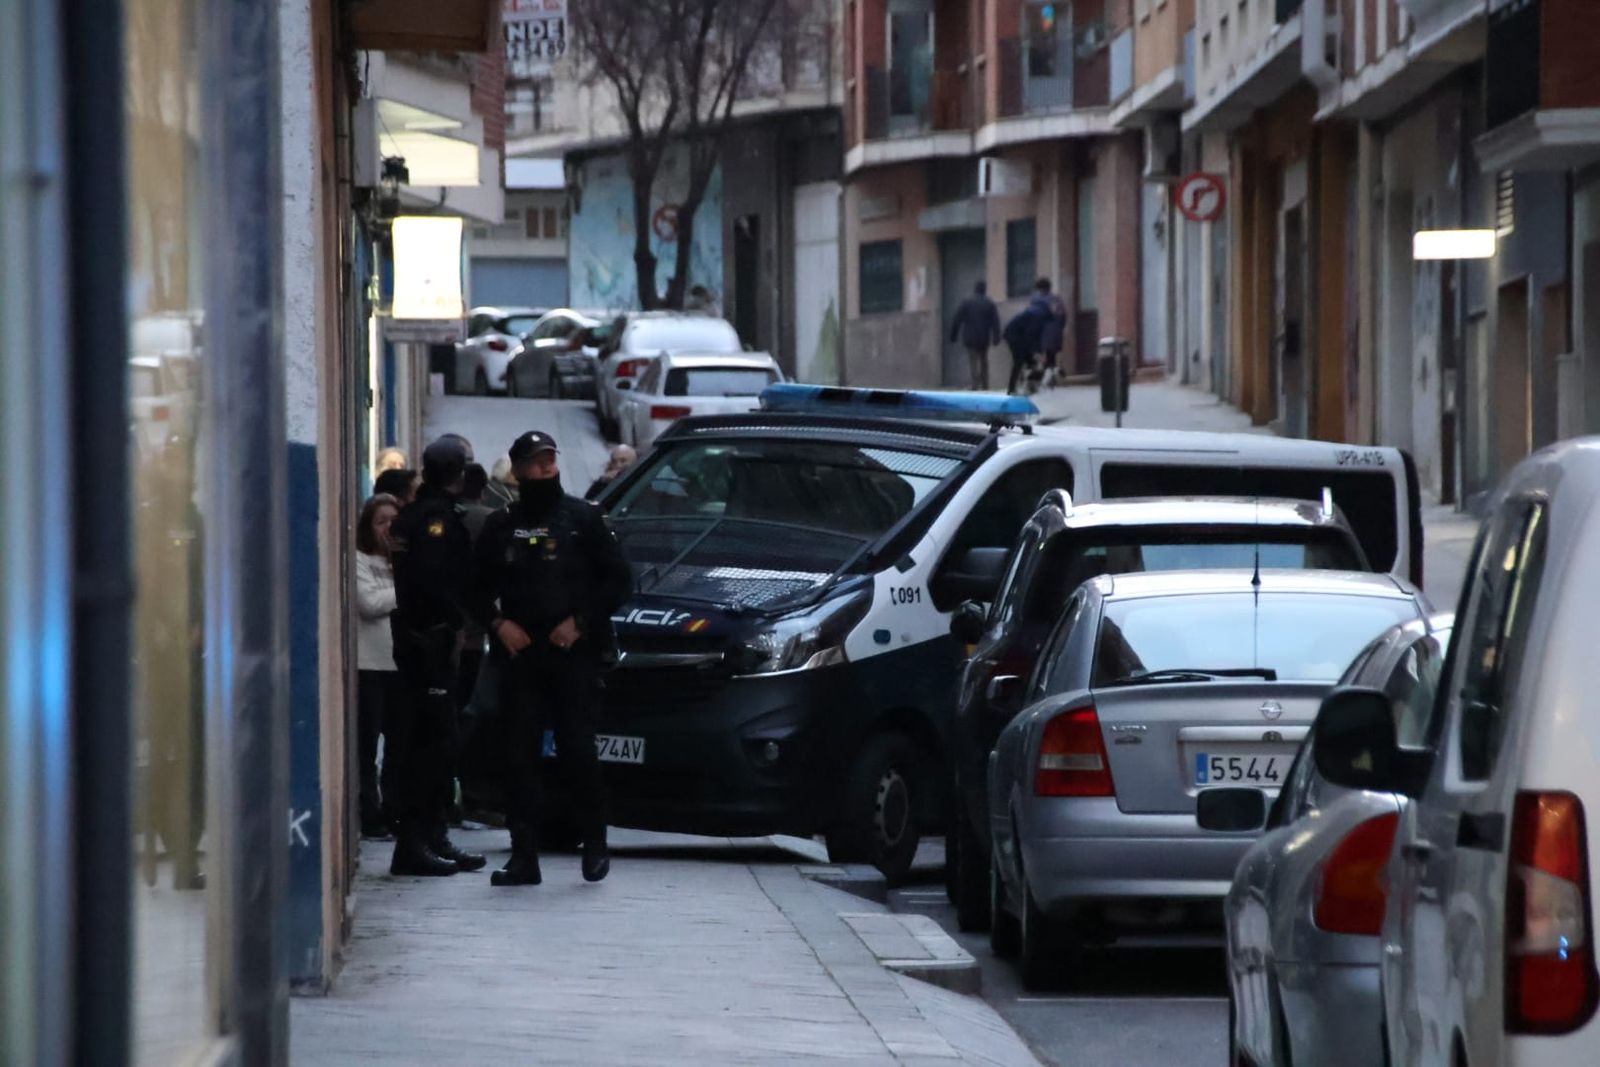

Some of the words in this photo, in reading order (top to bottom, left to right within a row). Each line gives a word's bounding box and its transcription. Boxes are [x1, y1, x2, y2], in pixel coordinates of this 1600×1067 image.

[898, 586, 921, 604] 091
[595, 737, 642, 761] 74AV
[1210, 756, 1279, 781] 5544
